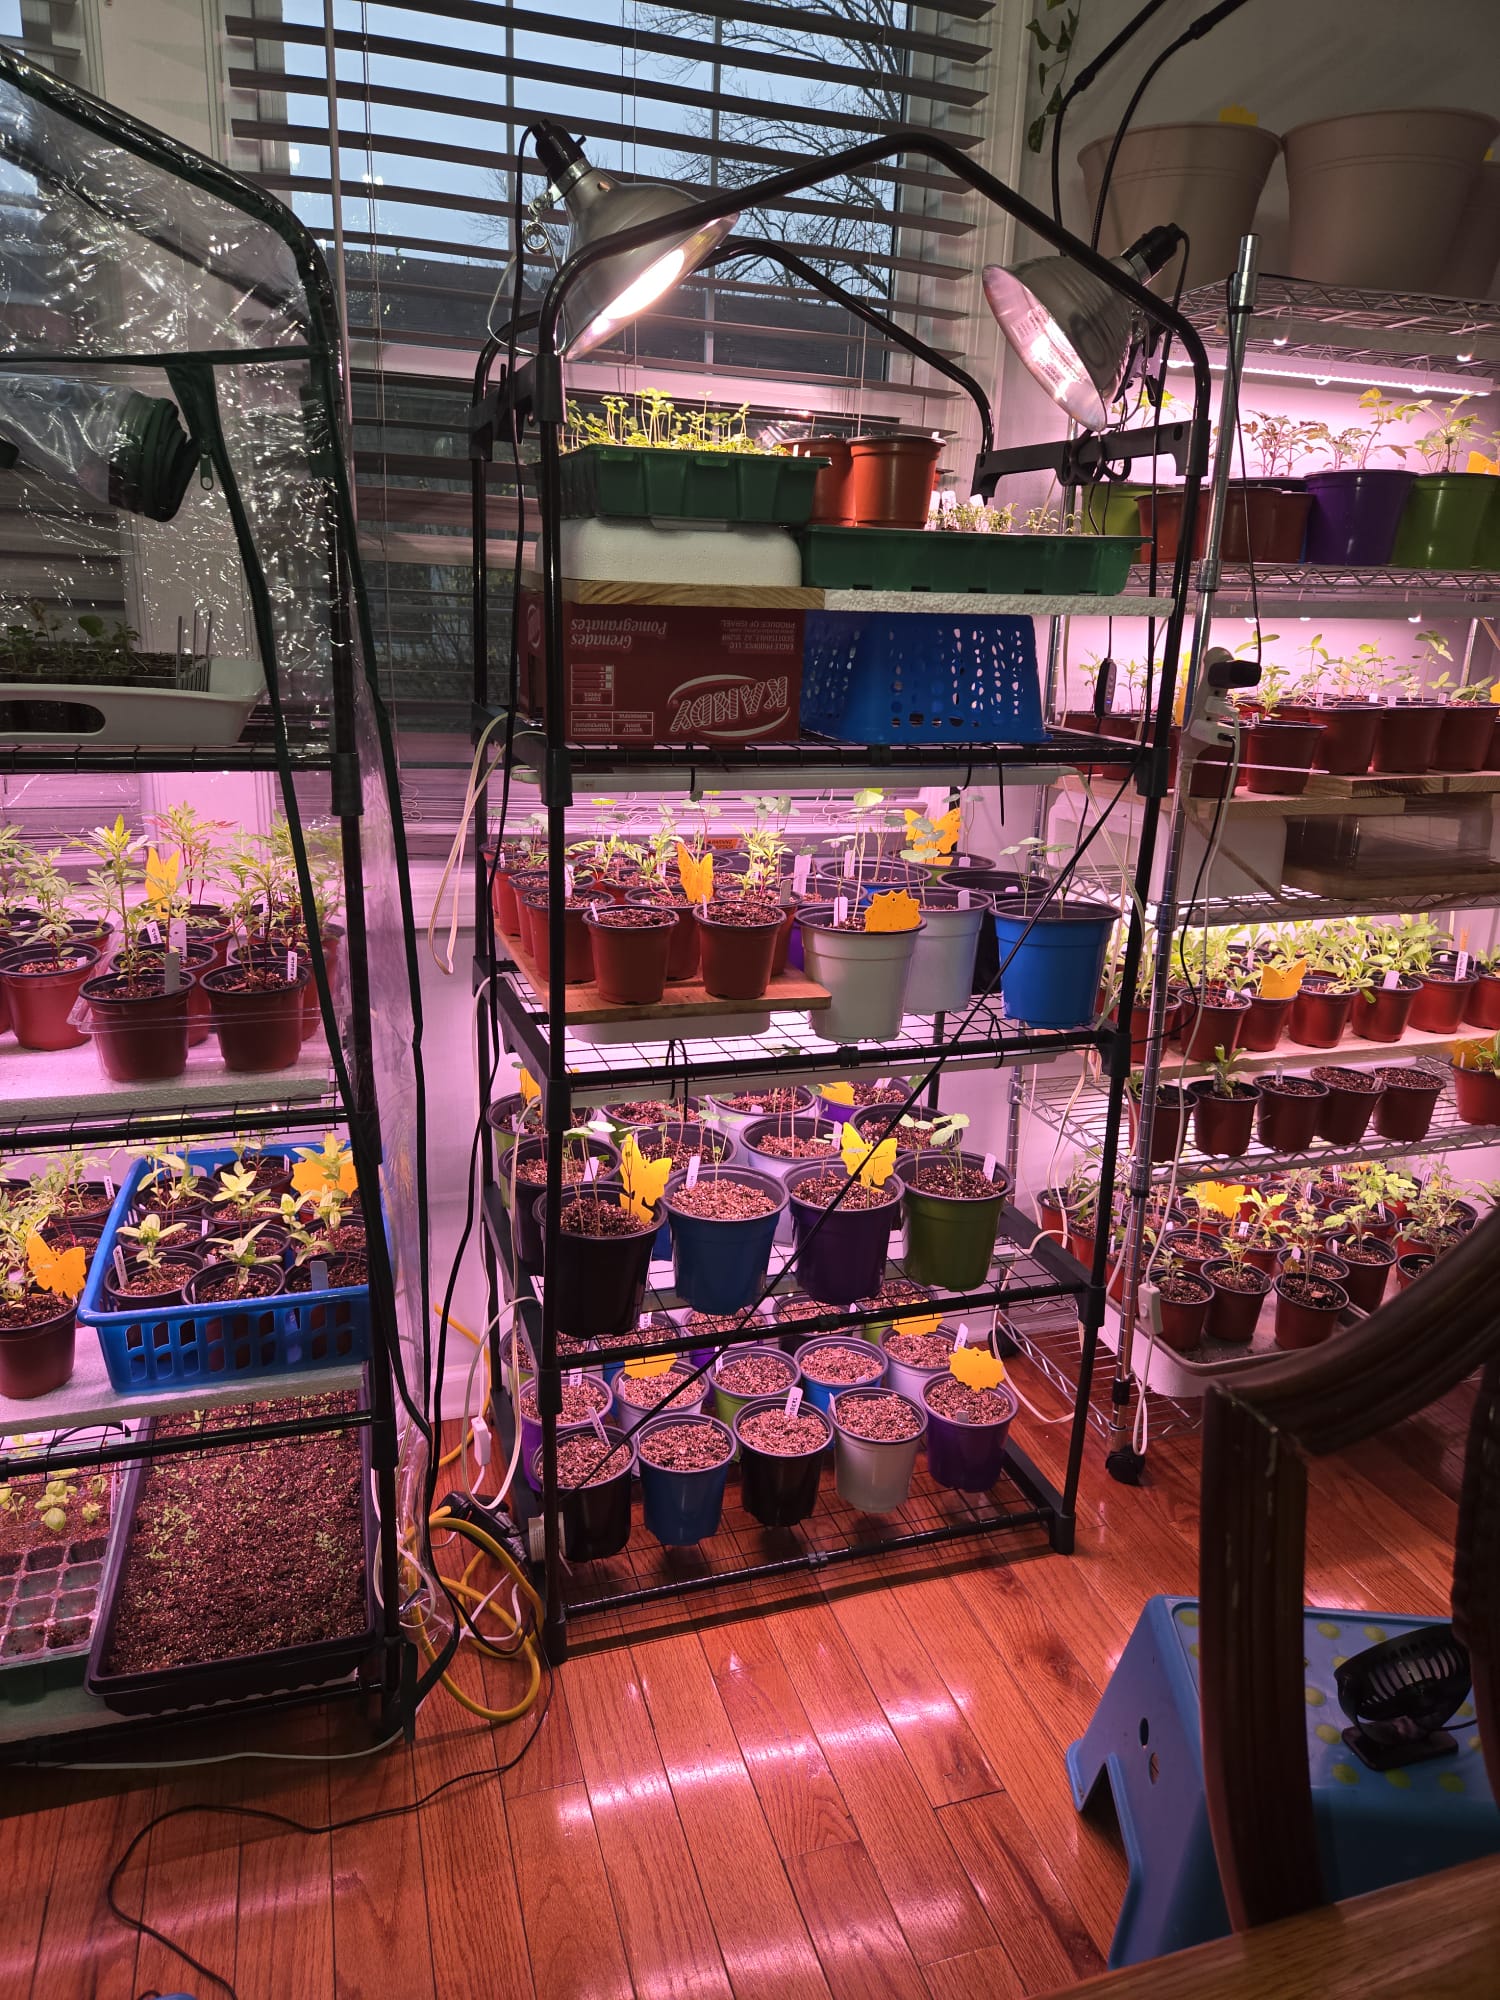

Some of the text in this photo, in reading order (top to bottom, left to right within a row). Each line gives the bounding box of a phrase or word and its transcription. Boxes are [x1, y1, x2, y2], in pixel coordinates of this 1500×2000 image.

[569, 618, 668, 635] Pomegranates
[570, 633, 632, 650] Grenades
[669, 675, 788, 733] KANDY
